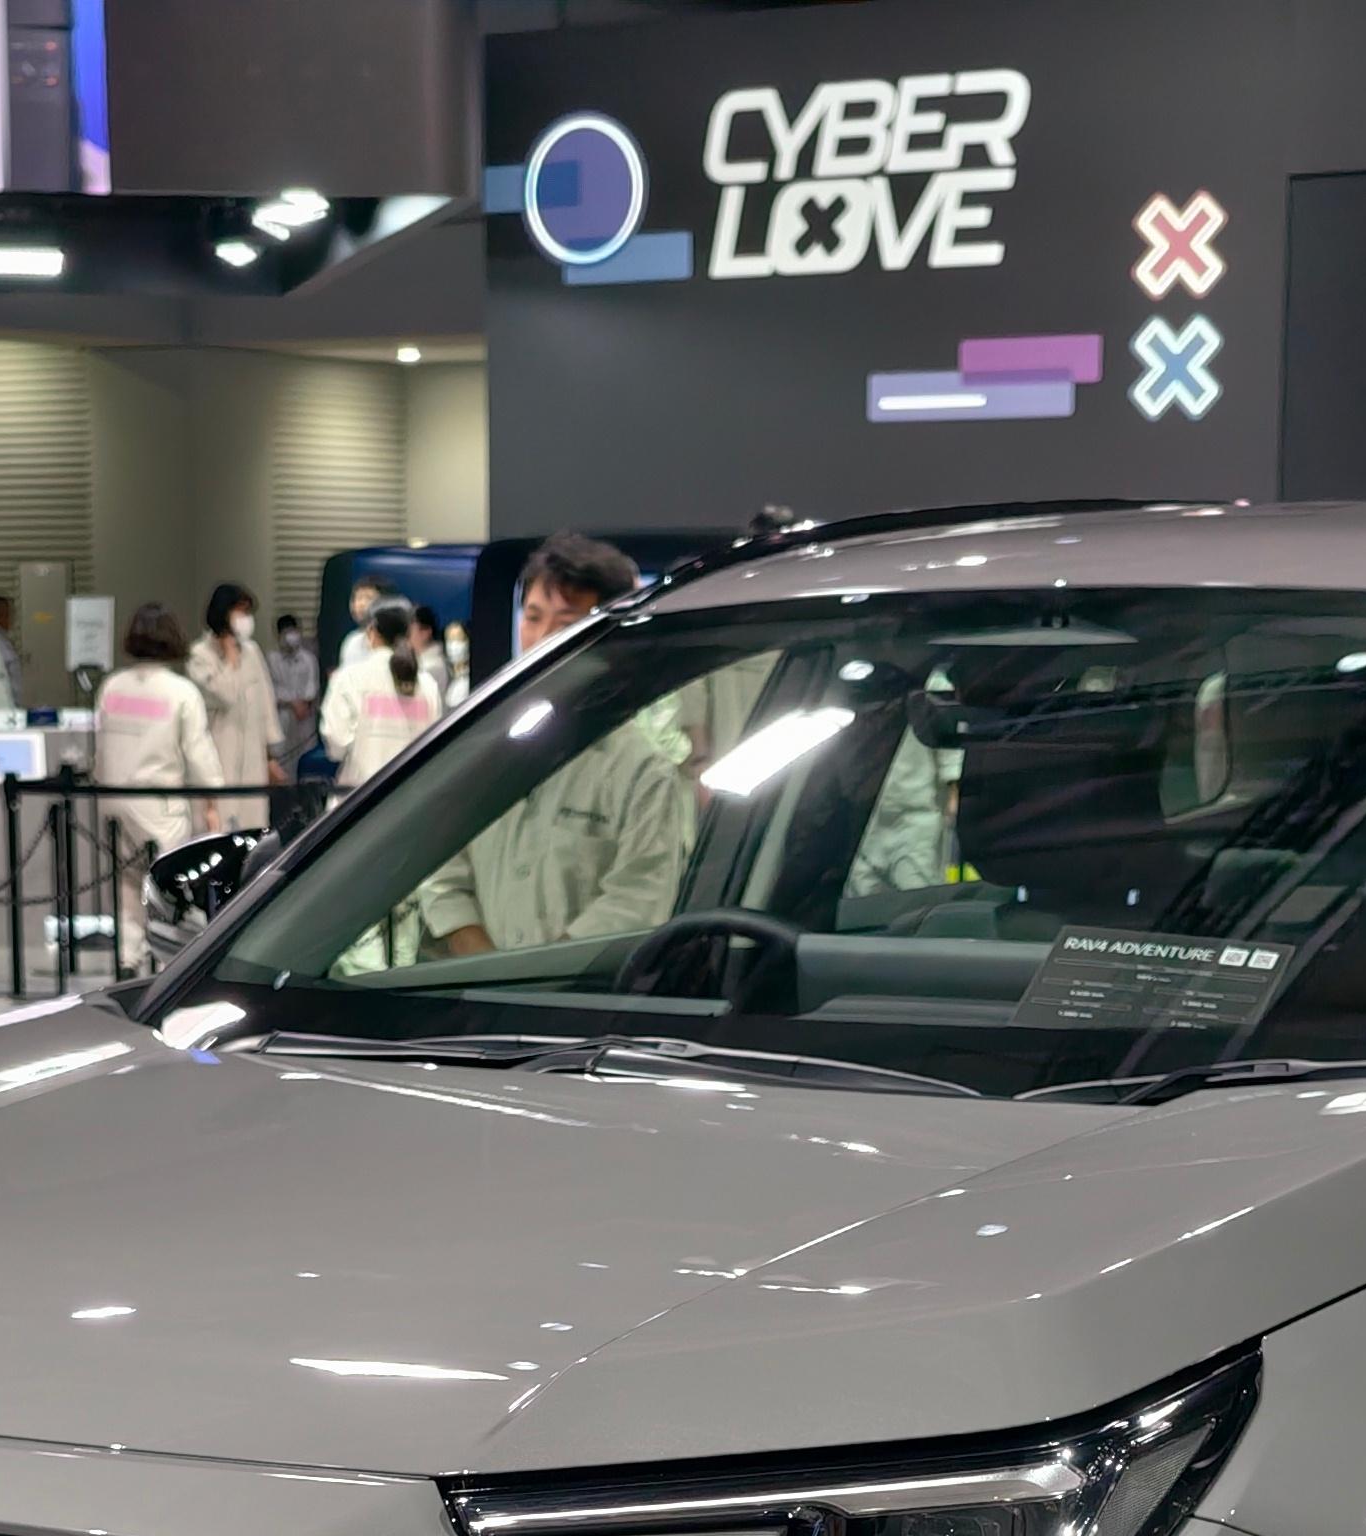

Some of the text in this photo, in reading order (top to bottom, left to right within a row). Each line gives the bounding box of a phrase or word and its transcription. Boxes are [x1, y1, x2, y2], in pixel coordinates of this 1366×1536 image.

[704, 67, 1032, 185] CYBER
[708, 167, 1018, 281] LOVE
[1063, 936, 1216, 962] RAV4 ADVENTURE
